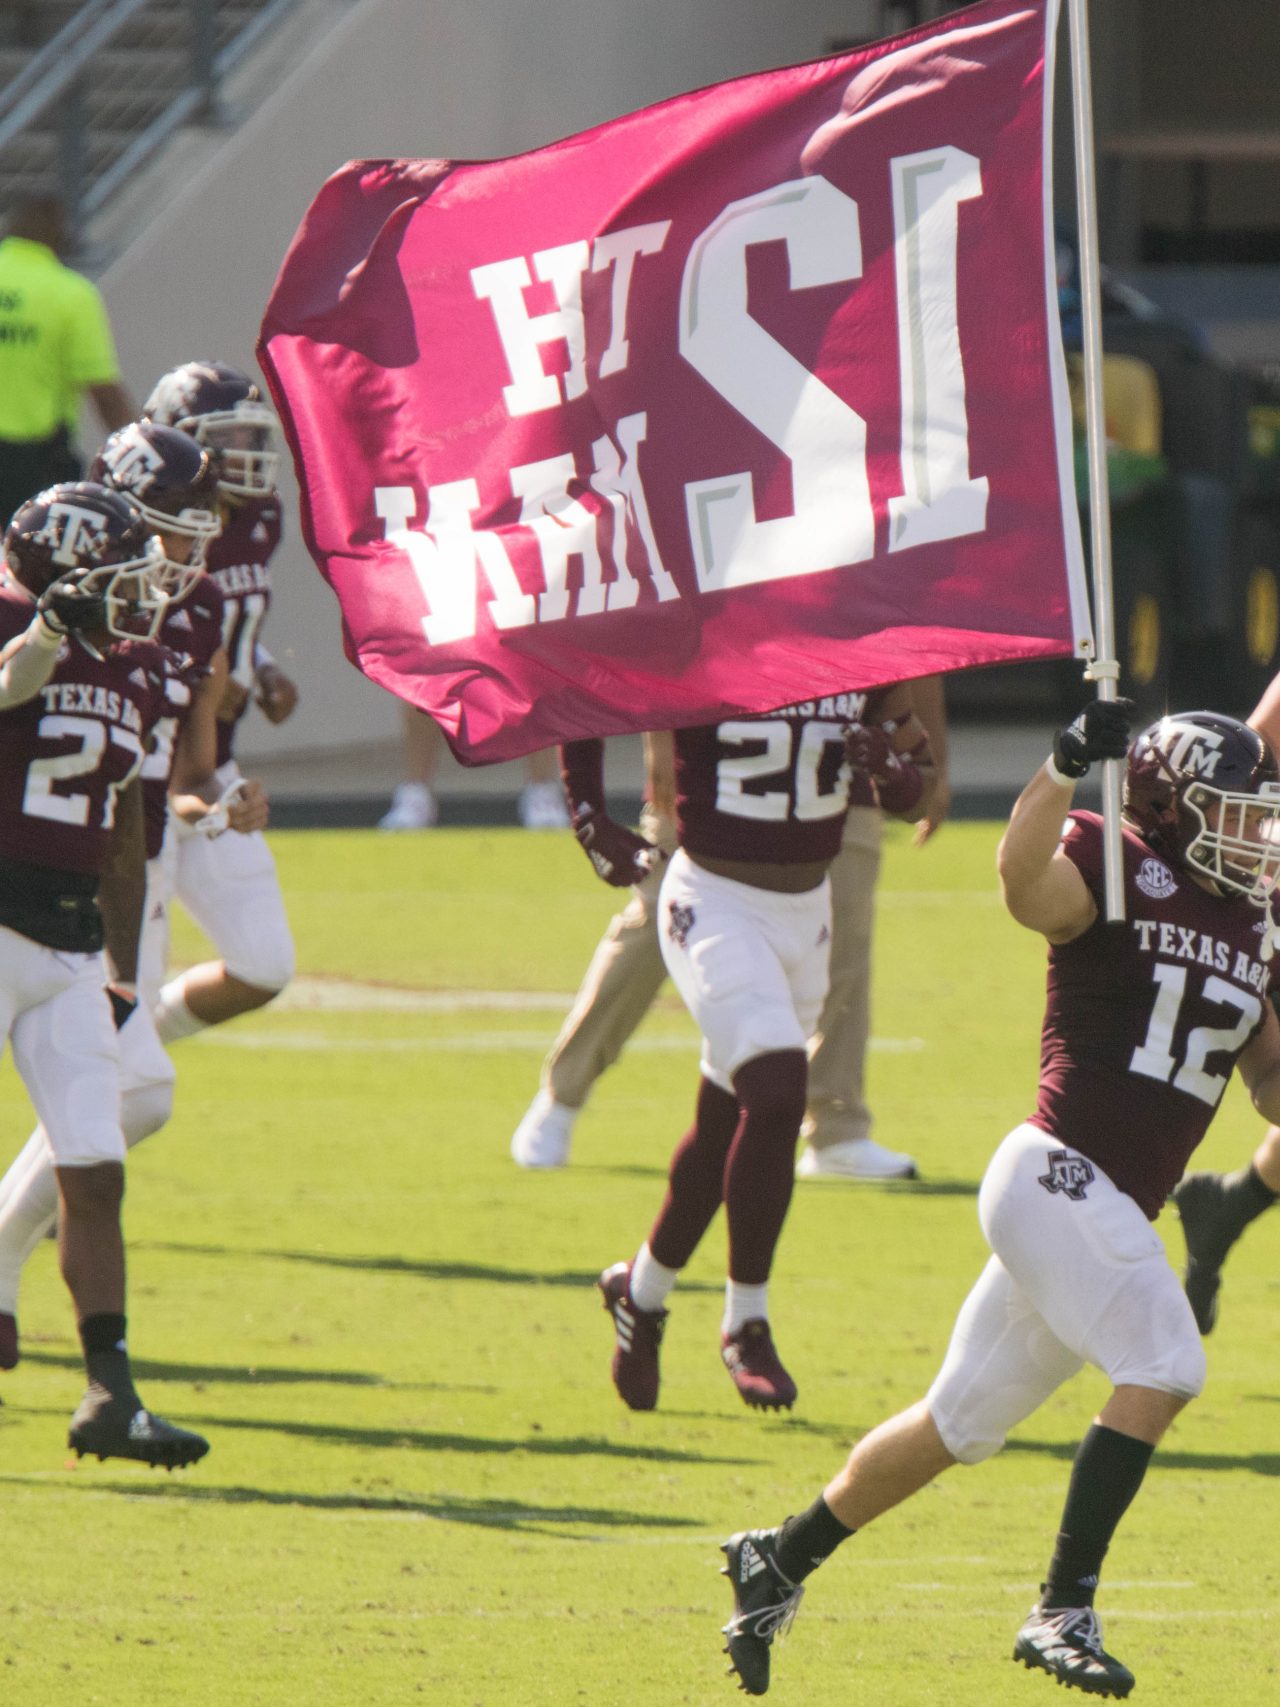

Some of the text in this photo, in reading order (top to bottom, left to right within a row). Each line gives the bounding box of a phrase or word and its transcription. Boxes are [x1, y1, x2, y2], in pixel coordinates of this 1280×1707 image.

[40, 683, 121, 719] TEXAS
[22, 714, 146, 830] 27
[715, 719, 852, 822] 20
[1134, 919, 1271, 999] TEXAS A&M
[1128, 962, 1263, 1108] 12
